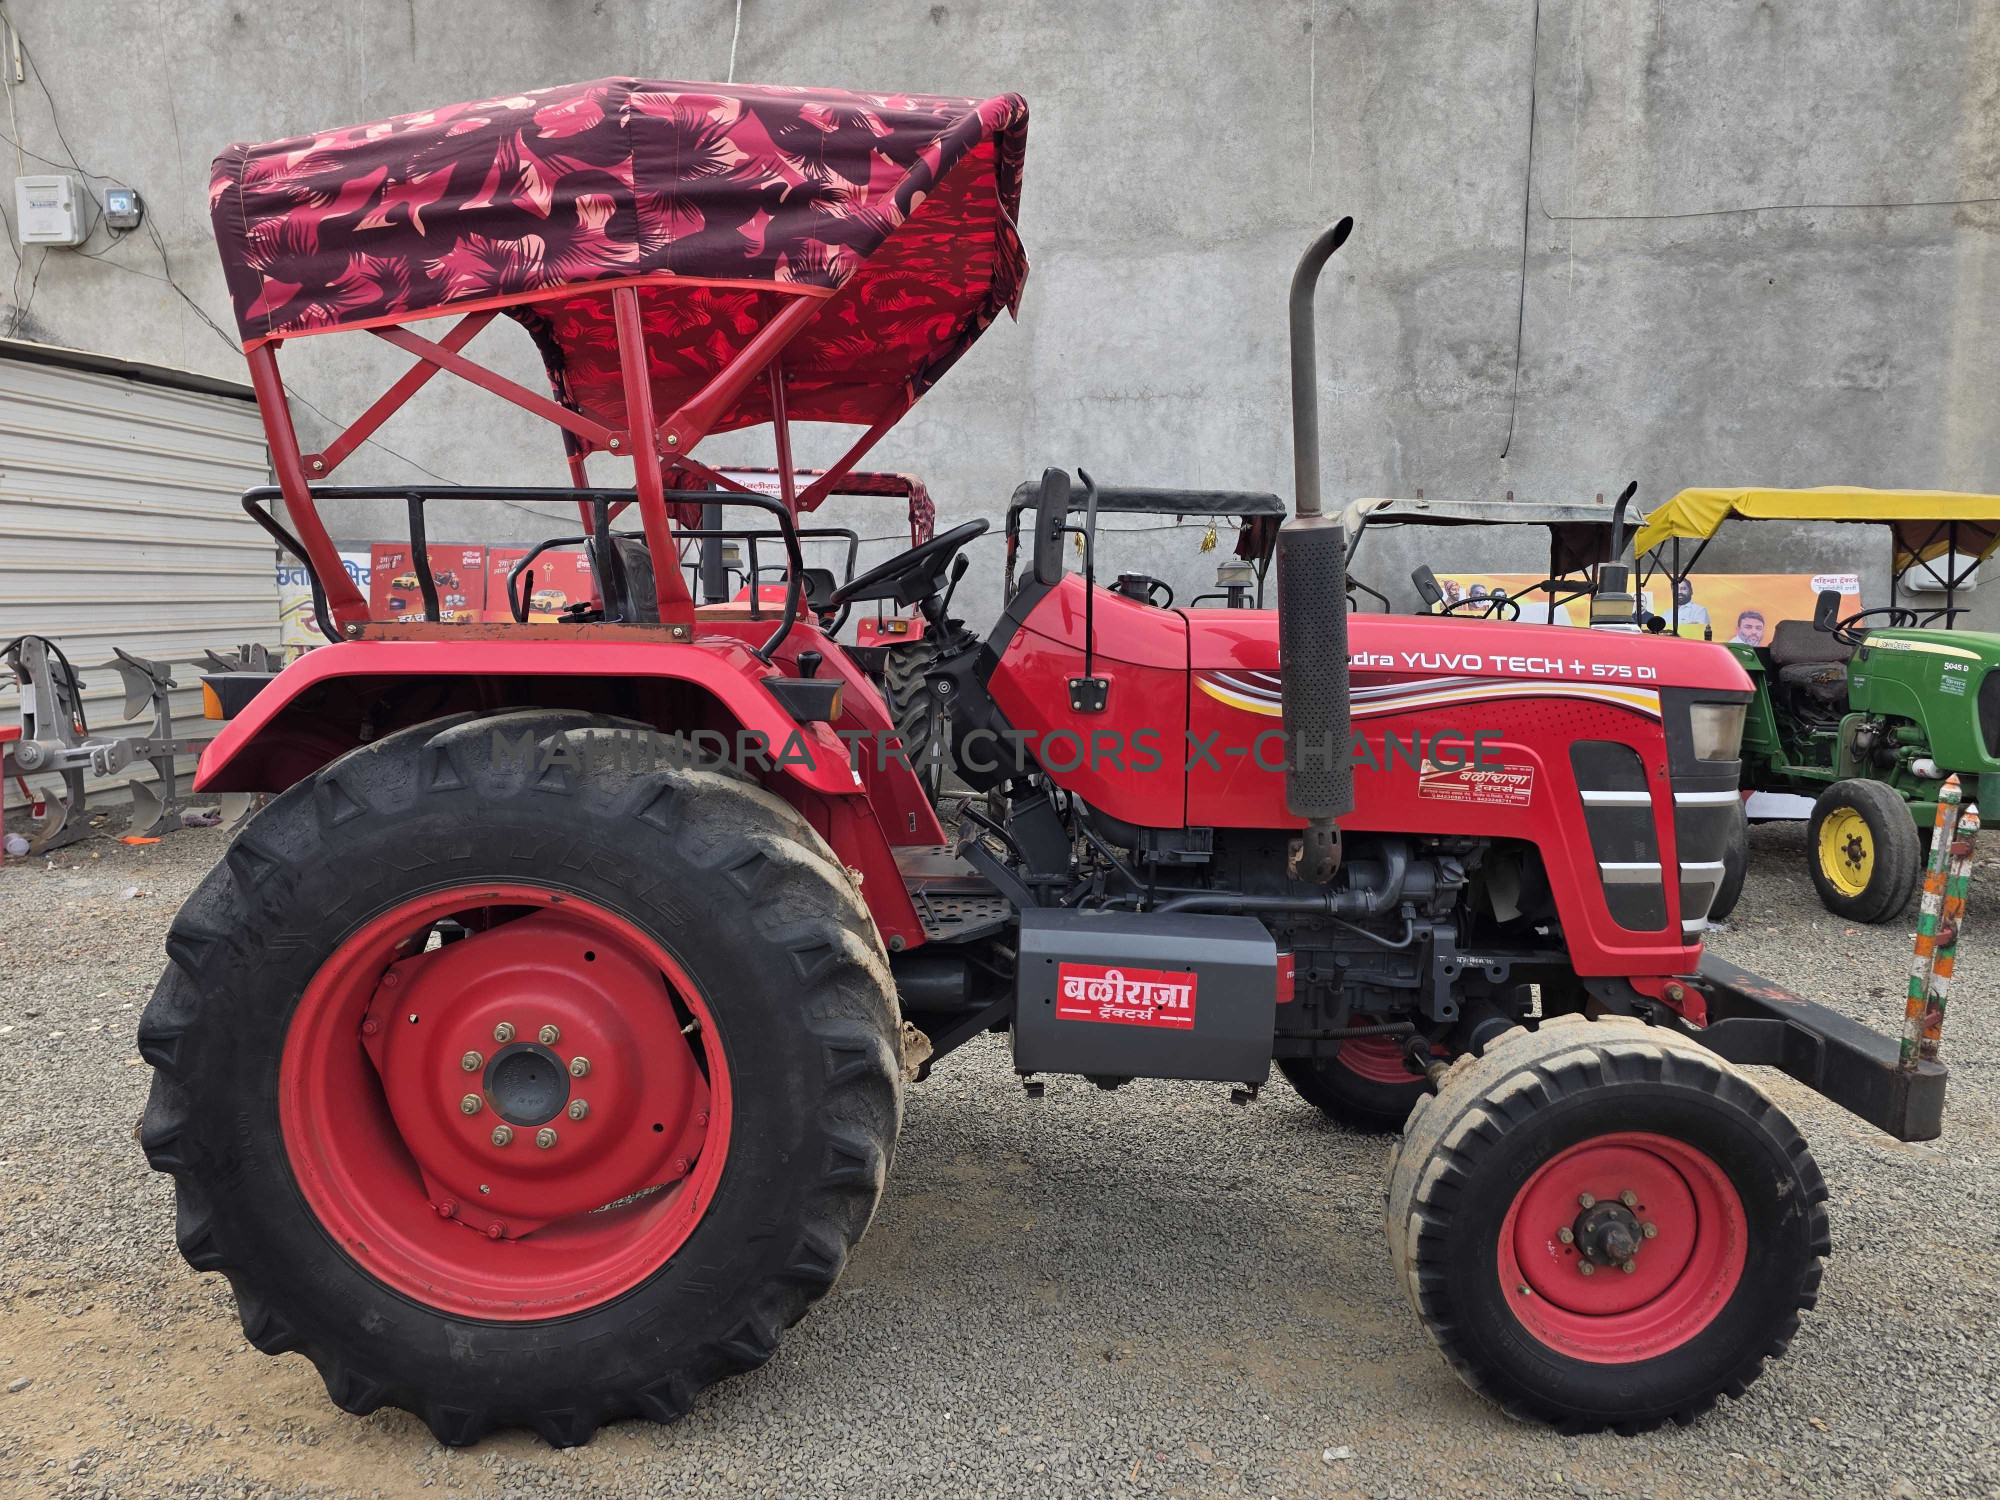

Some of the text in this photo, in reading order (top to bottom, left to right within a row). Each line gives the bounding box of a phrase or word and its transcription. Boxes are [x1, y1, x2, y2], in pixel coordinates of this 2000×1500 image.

[1400, 652, 1483, 670] YUVO
[1489, 655, 1564, 674] TECH
[1569, 659, 1586, 675] +
[1592, 664, 1633, 677] 575
[1637, 666, 1657, 679] DI
[1943, 661, 1962, 671] 5045
[1062, 969, 1193, 1009] बळीराजा
[1098, 1004, 1155, 1020] ट्रॅक्टर्स
